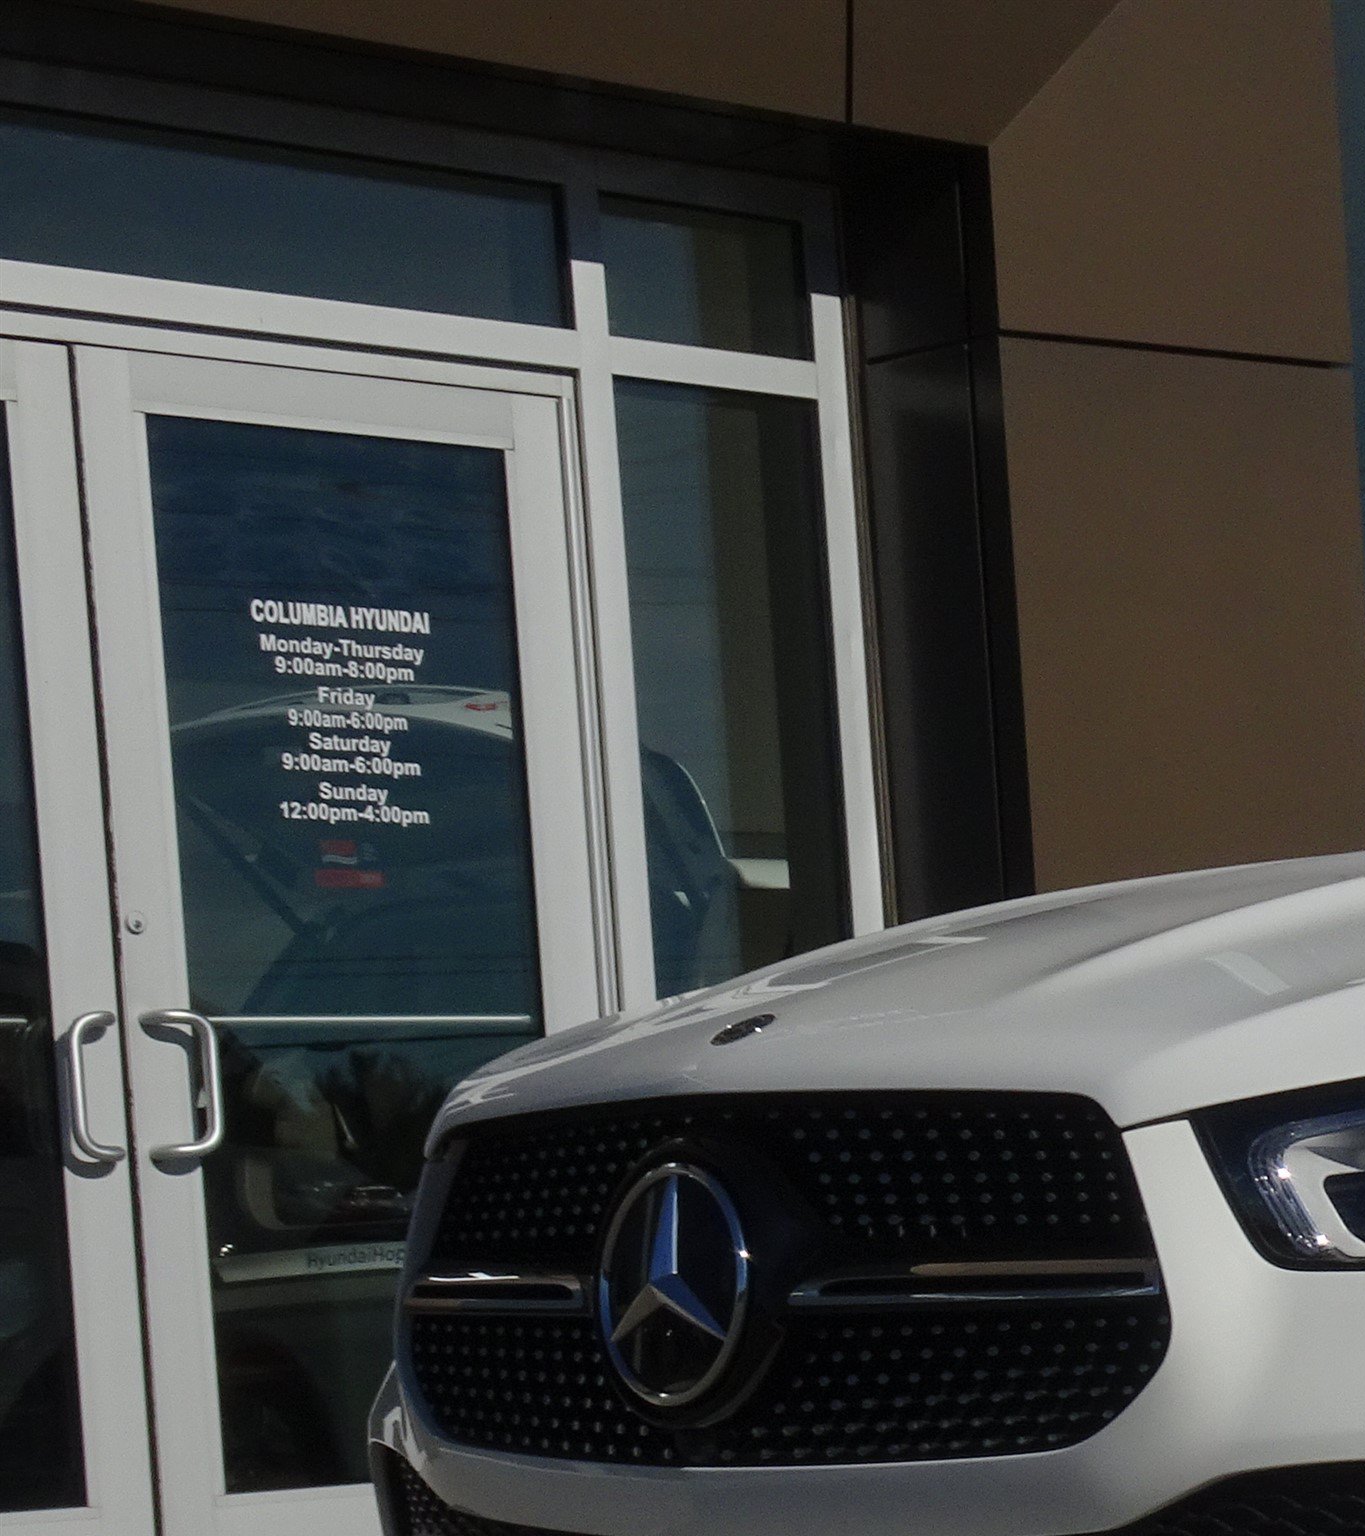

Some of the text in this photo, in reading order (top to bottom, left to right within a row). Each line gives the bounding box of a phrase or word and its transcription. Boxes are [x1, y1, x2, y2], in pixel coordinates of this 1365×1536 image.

[250, 599, 431, 634] COLUMBIA HYUNDAI
[259, 634, 424, 665] Monday-Thursday
[274, 656, 415, 683] 9:00am-8:00pm
[317, 686, 375, 711] Friday
[287, 709, 408, 734] 9:00am-6:00pm
[309, 732, 391, 757] Saturday
[281, 753, 421, 779] 9:00am-6:00pm
[319, 781, 389, 806] Sunday
[279, 801, 430, 827] 12:00pm-4:00pm
